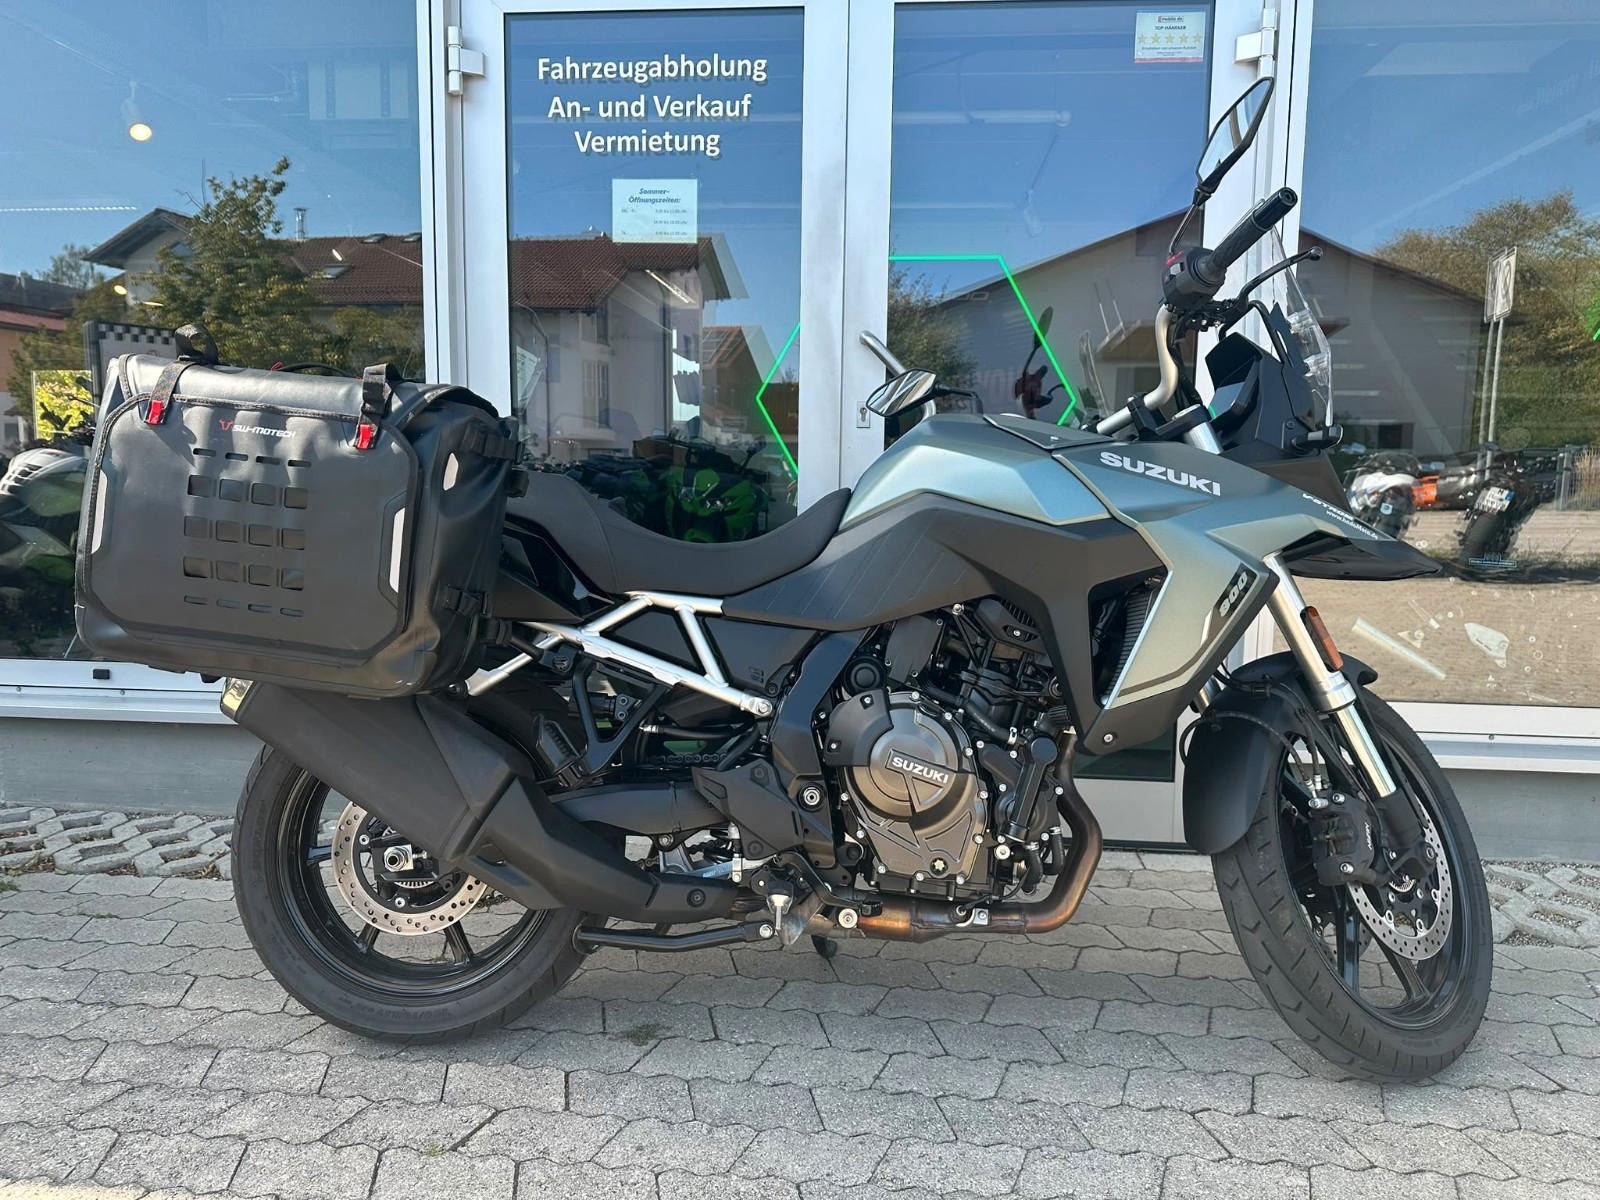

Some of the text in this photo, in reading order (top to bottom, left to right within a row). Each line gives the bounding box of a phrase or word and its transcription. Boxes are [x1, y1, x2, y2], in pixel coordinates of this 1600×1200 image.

[537, 53, 767, 81] Fahrzeugabholung
[548, 94, 752, 118] An- und Verkauf
[574, 129, 720, 156] Vermietung
[639, 187, 670, 195] Sommer-
[232, 424, 297, 438] SW-MOTECH
[1100, 451, 1221, 497] SUZUKI
[1219, 571, 1248, 617] 800
[891, 756, 949, 784] SUZUKI
